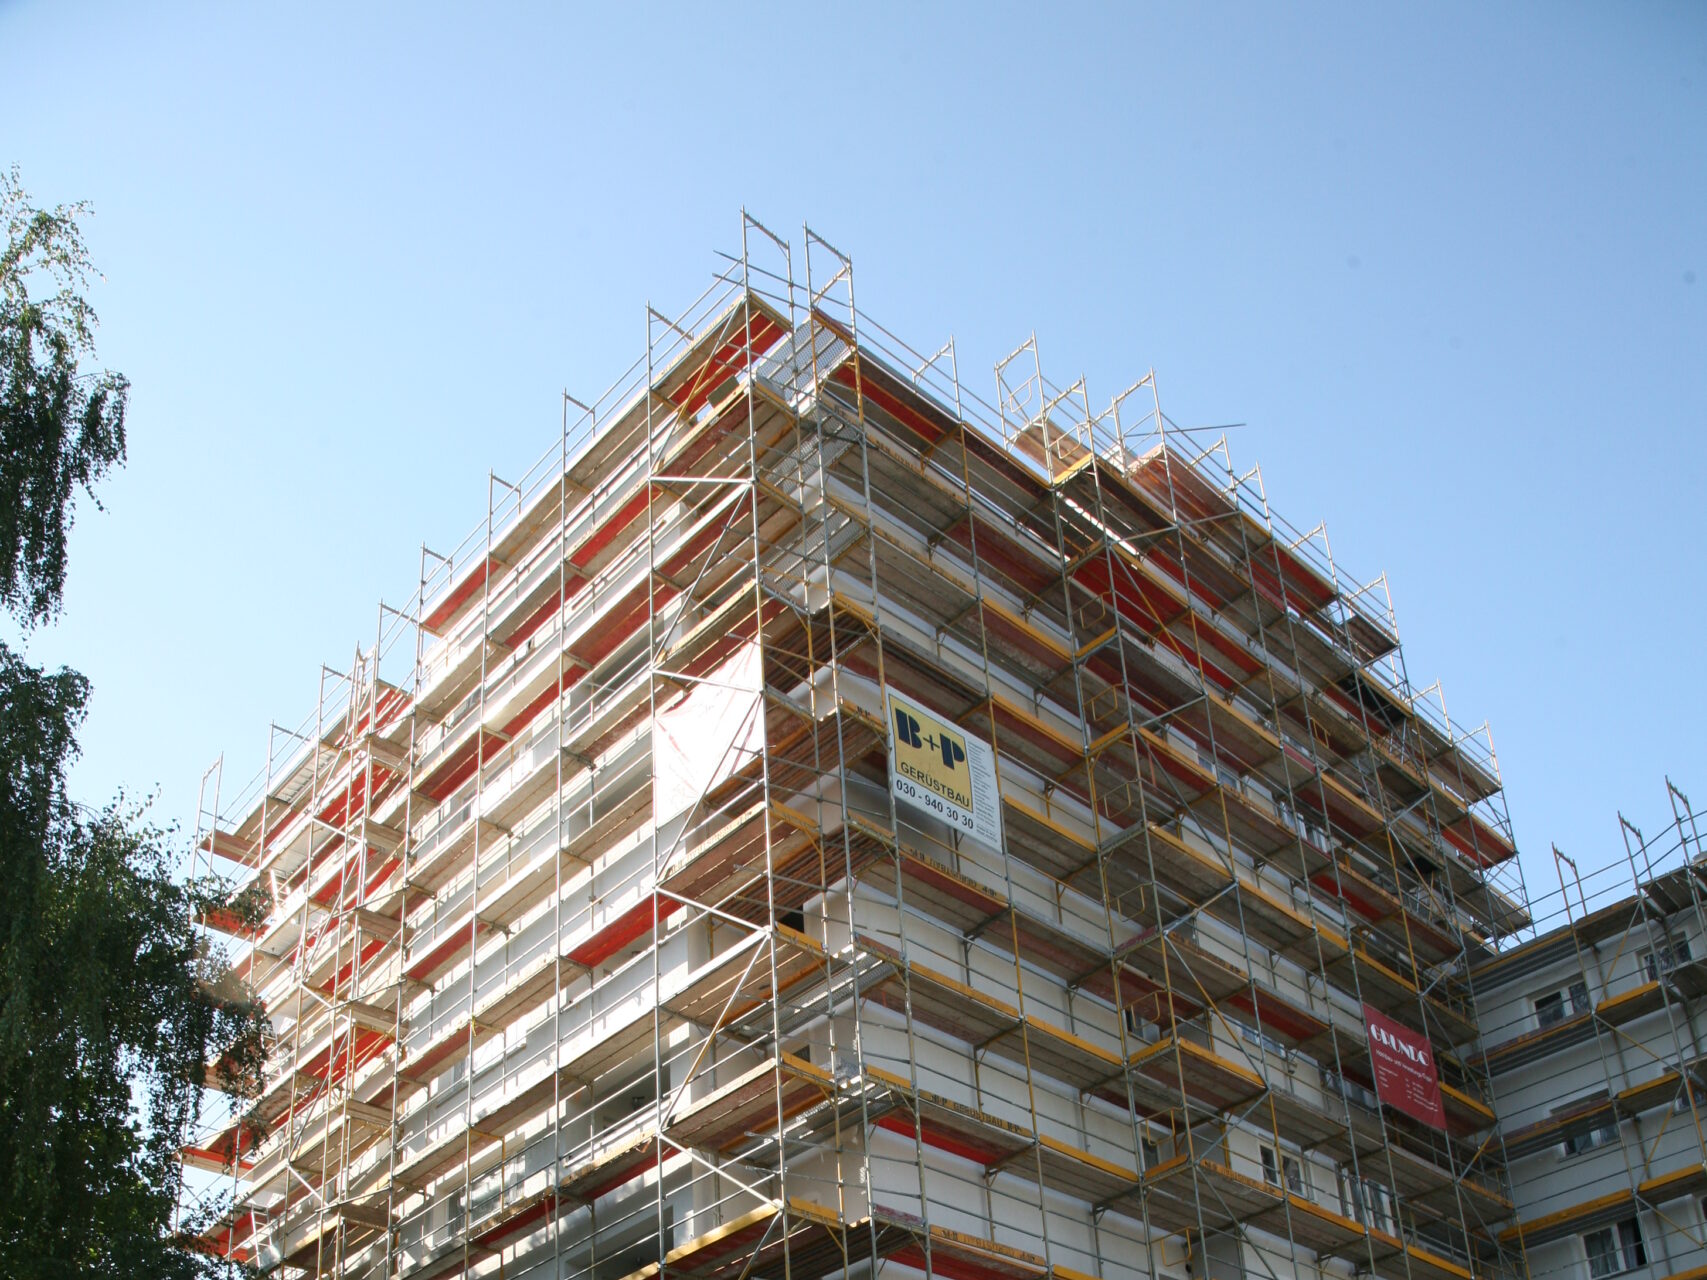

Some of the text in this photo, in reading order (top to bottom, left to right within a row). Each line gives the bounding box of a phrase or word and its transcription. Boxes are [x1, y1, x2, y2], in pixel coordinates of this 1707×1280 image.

[895, 708, 965, 770] B+P
[896, 779, 916, 798] 030
[924, 794, 943, 813] 940
[946, 807, 959, 821] 30
[961, 815, 974, 829] 30
[901, 762, 969, 807] GERÜSTBAU
